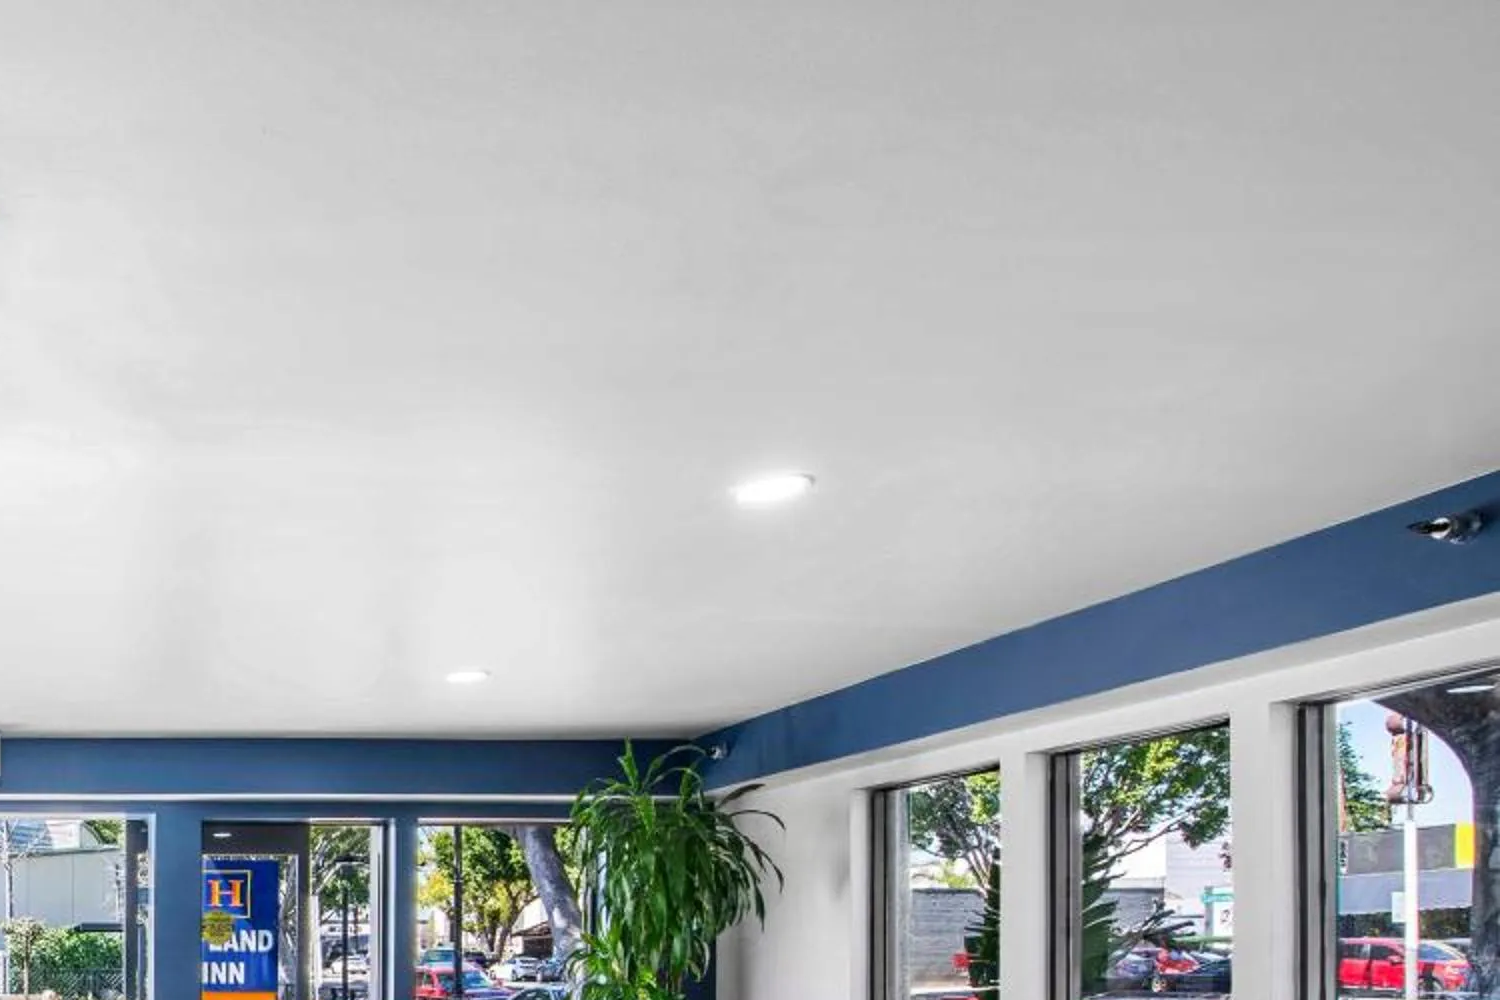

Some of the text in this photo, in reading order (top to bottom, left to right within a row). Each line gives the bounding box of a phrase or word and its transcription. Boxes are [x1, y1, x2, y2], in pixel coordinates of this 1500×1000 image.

[207, 879, 245, 908] H
[208, 929, 274, 953] AND
[202, 961, 245, 985] INN
